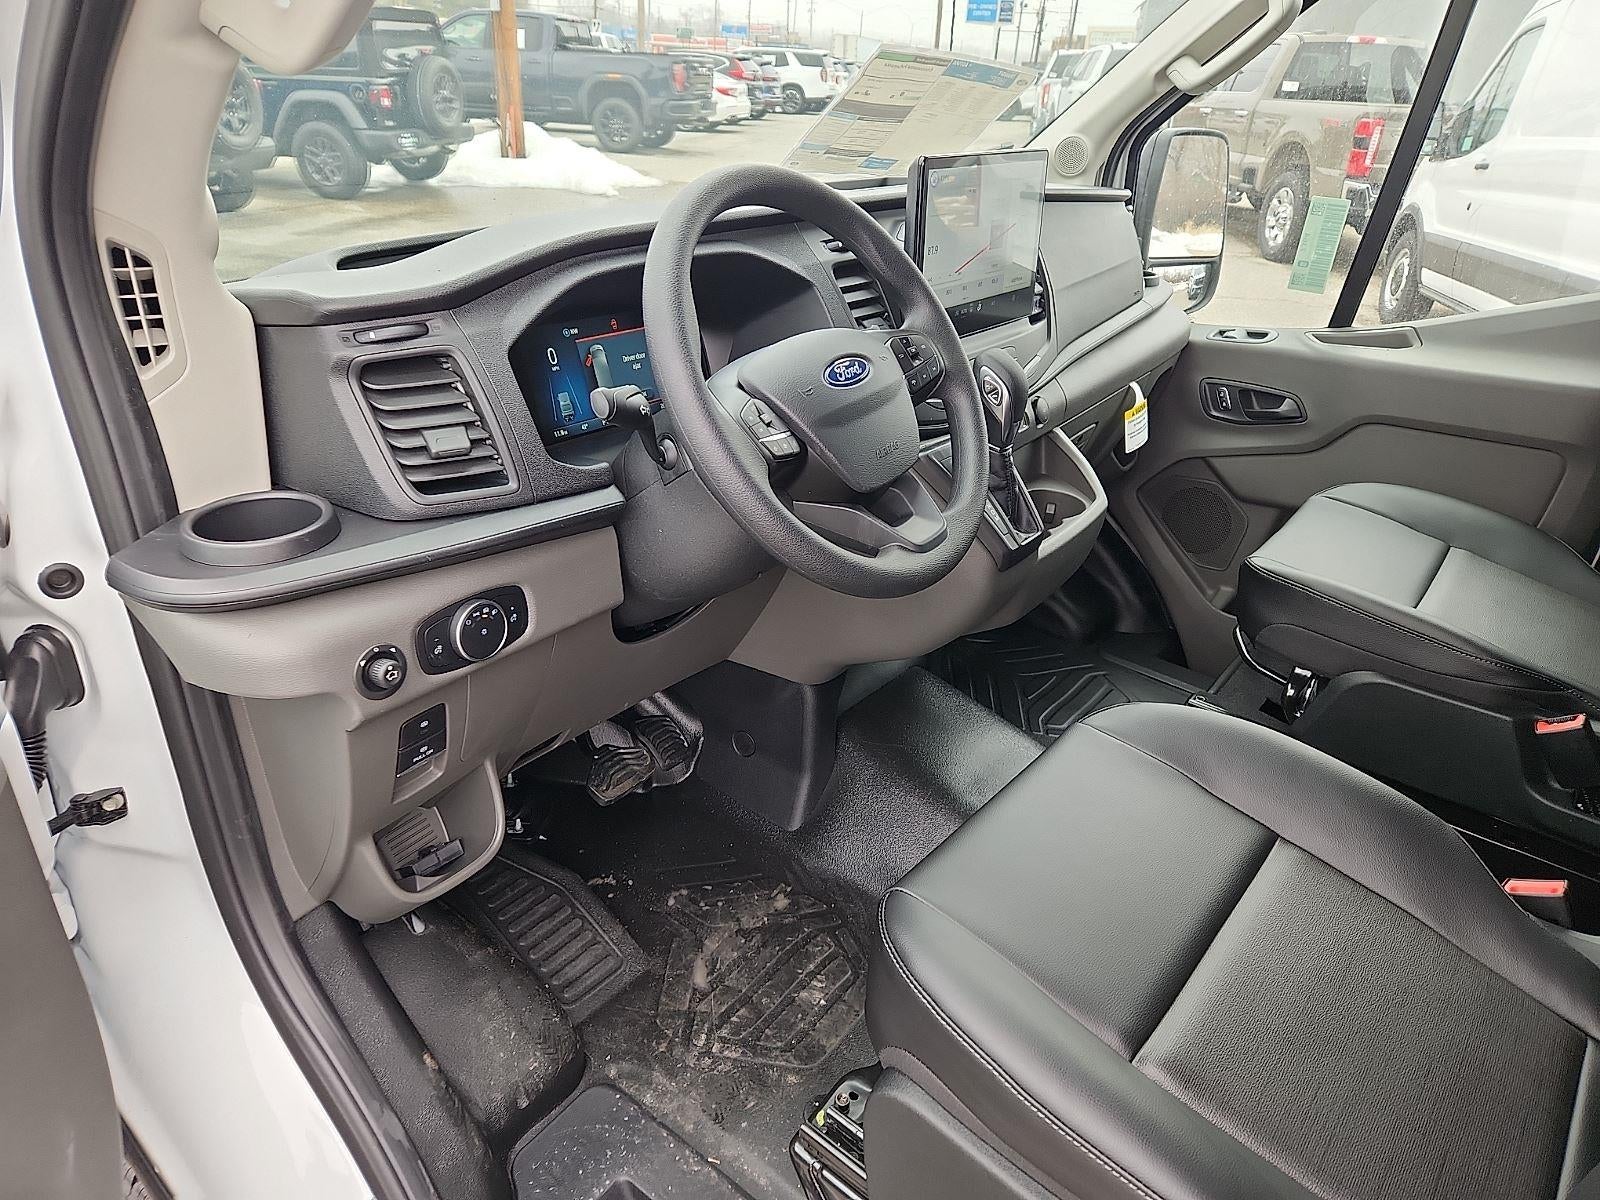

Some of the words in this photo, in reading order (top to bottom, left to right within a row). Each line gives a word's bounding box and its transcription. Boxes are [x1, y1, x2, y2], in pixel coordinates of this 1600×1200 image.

[546, 347, 558, 365] 0
[622, 354, 636, 363] Driver
[635, 352, 646, 360] door
[833, 361, 863, 381] Ford
[875, 440, 900, 460] AIRBAG
[412, 754, 426, 763] PULL
[425, 748, 434, 756] ON
